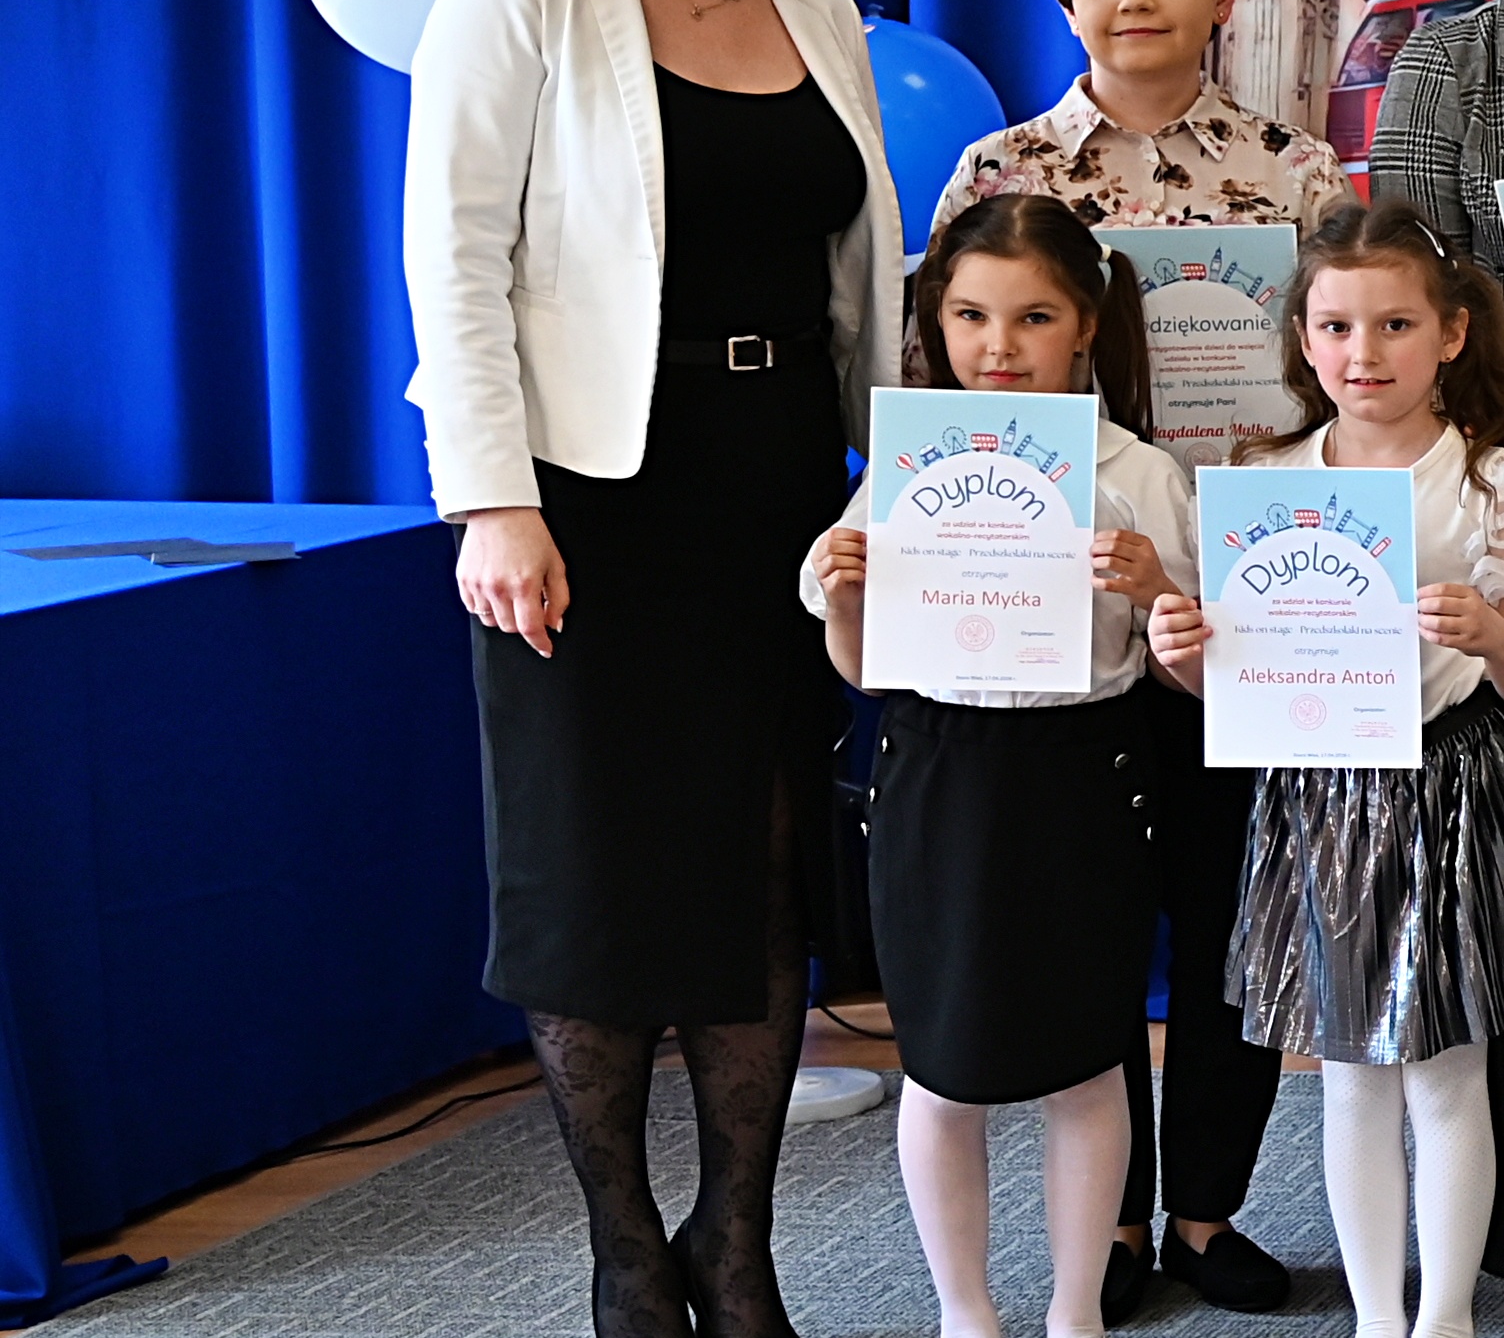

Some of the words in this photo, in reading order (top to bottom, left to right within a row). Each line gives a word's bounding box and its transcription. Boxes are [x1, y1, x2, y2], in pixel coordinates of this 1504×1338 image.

[1147, 315, 1272, 336] dziękowanie
[1168, 399, 1214, 408] otrzymuje
[912, 465, 1045, 520] Dyplom
[936, 531, 1030, 542] wokalno-recytatorskim
[901, 546, 920, 555] Kids
[937, 548, 961, 559] stage
[969, 547, 1031, 557] Przedszkolaki
[1047, 550, 1076, 558] scenie
[962, 570, 1008, 580] otrzymuje
[1241, 541, 1370, 596] Dyplom
[922, 589, 975, 605] Maria
[982, 590, 1042, 609] Myćka
[1294, 648, 1338, 657] otrzymuje
[1238, 668, 1336, 684] Aleksandra
[1342, 669, 1395, 685] Antoń
